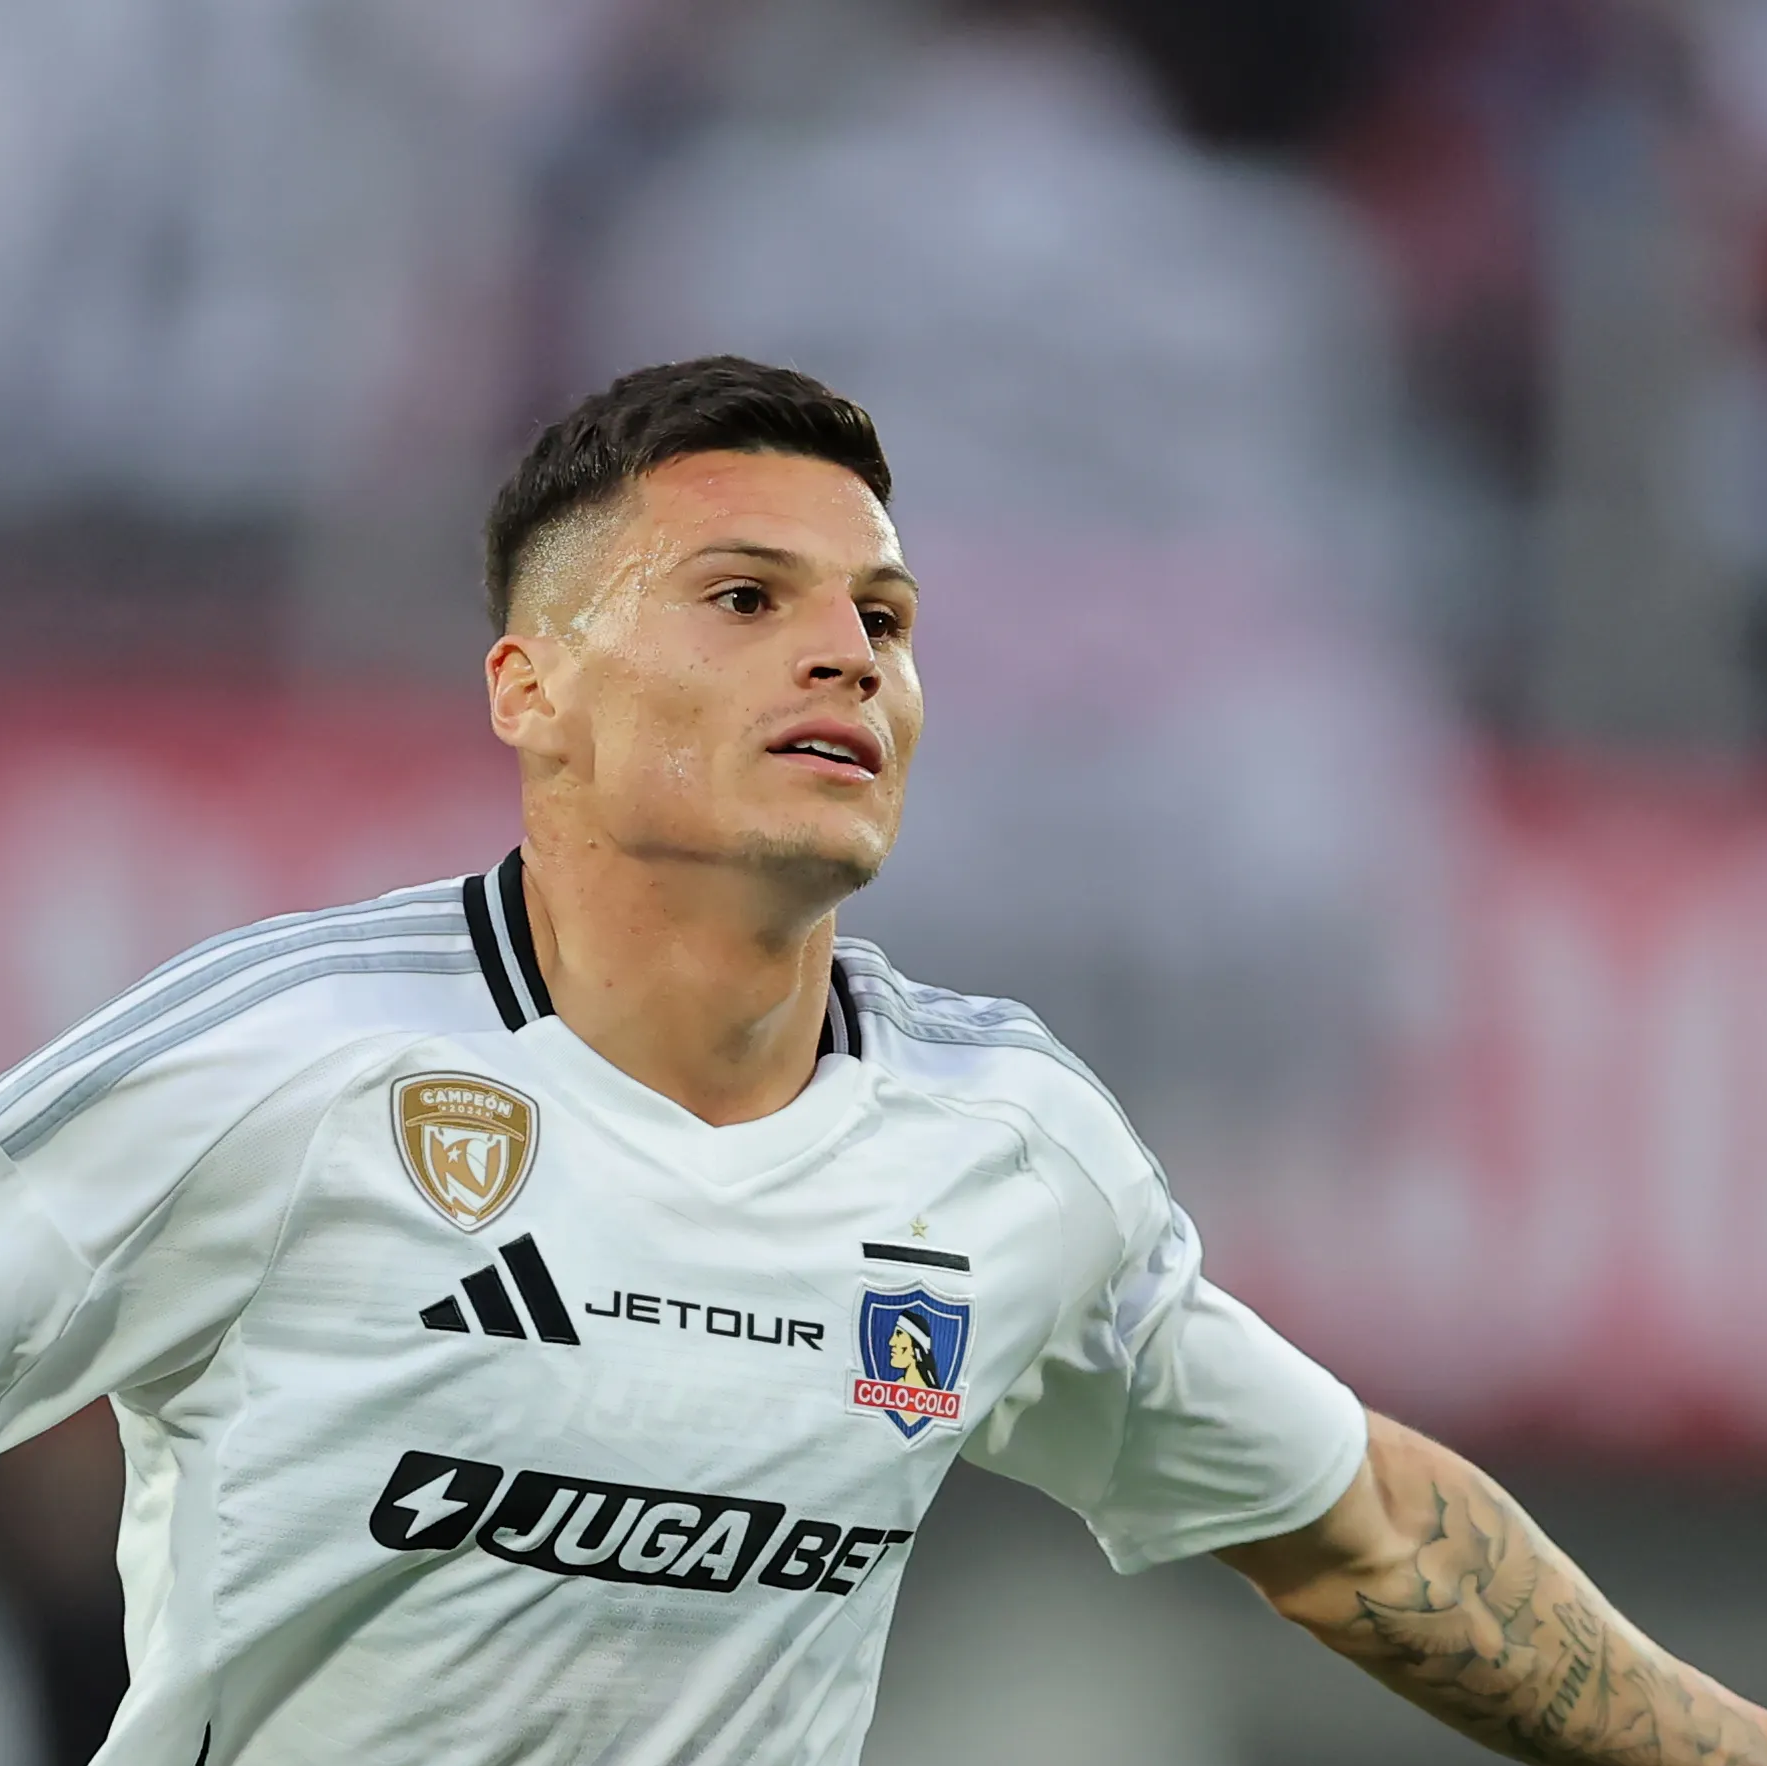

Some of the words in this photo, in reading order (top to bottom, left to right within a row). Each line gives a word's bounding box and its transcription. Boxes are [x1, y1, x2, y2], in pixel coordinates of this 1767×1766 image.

[422, 1089, 512, 1116] CAMPEÓN
[449, 1105, 483, 1116] 2024
[585, 1290, 825, 1351] JETOUR
[857, 1382, 957, 1416] COLO-COLO
